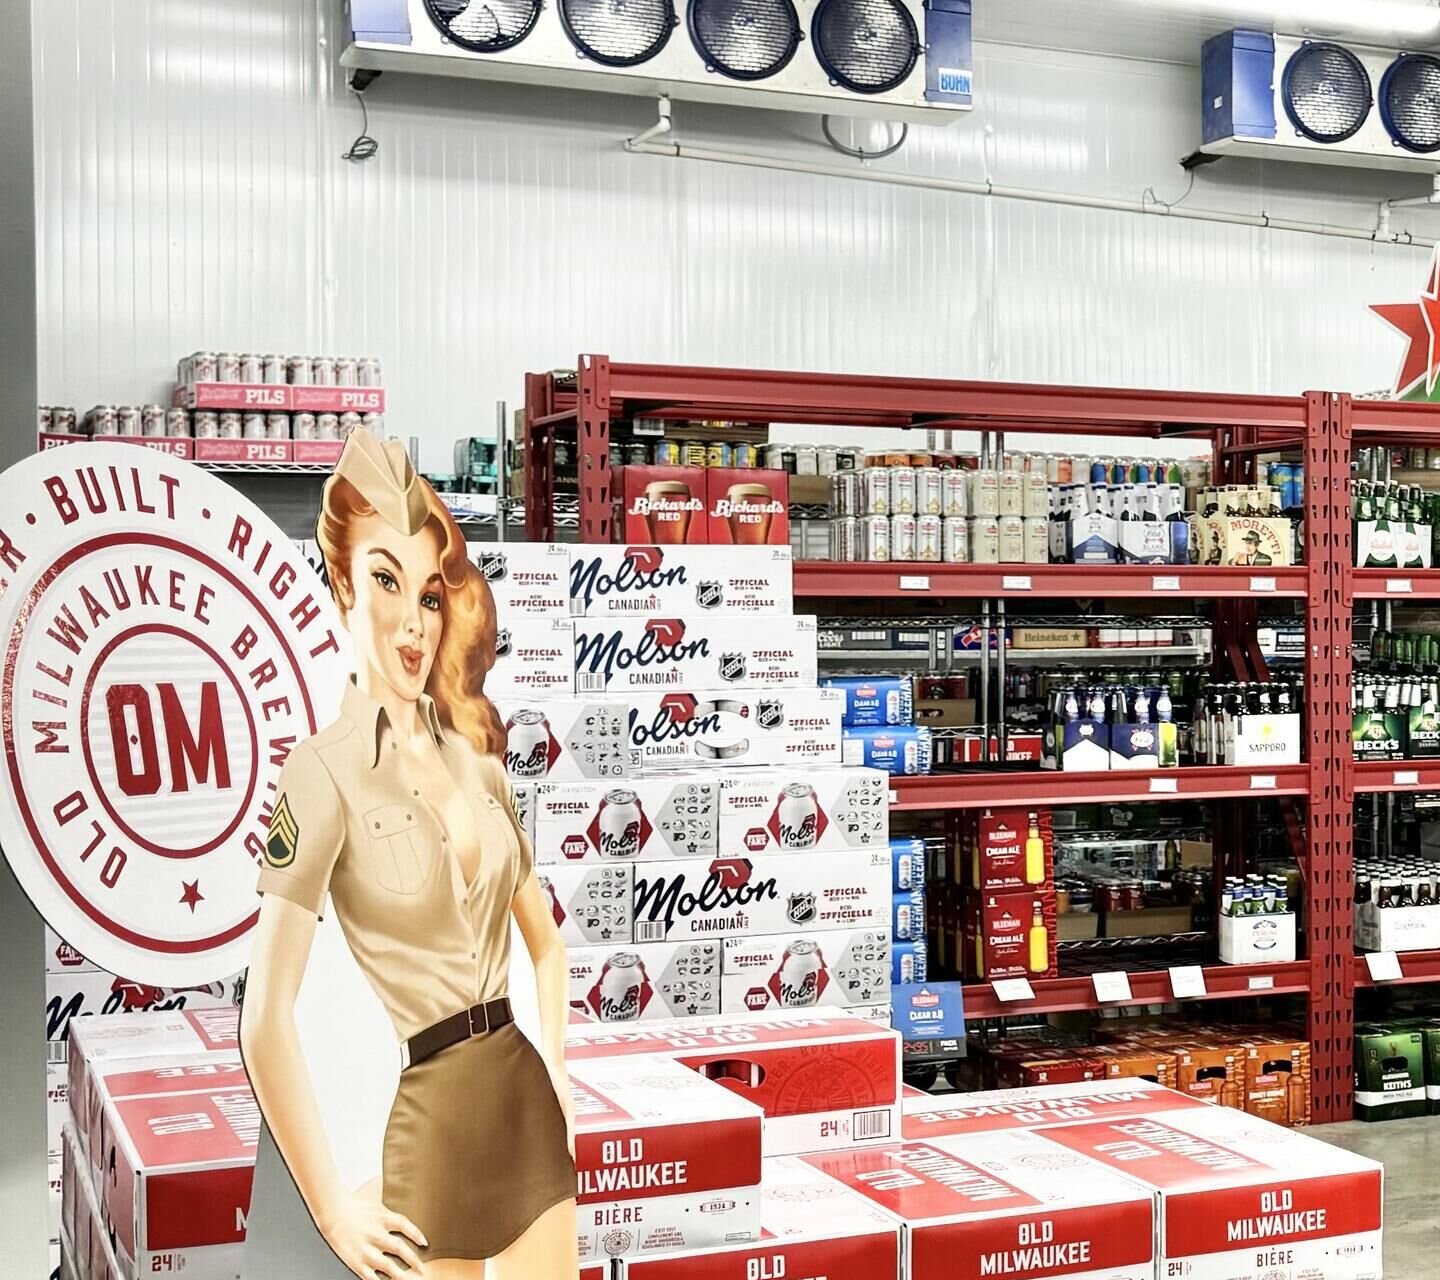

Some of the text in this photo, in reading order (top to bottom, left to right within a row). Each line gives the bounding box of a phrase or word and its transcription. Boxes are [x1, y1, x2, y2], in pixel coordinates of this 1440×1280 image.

[941, 72, 971, 95] BOHN
[246, 389, 286, 405] PILS
[341, 392, 381, 408] PILS
[247, 444, 287, 461] PILS
[628, 497, 704, 516] Rickard's
[711, 498, 785, 516] Rickard's
[658, 512, 681, 522] RED
[740, 513, 762, 524] RED
[1231, 518, 1282, 556] MORETTI
[43, 465, 340, 659] BUILT RIGHT
[513, 572, 559, 581] OFFICIAL
[570, 555, 688, 611] Molson
[509, 599, 565, 608] OFFICIELLE
[608, 594, 657, 610] CANADIAN
[1024, 632, 1069, 643] Heineken
[575, 630, 710, 685] Molson
[629, 667, 680, 685] CANADIAN
[33, 564, 297, 890] OLD MILWAUKEE BREWG
[104, 679, 234, 797] OM
[1249, 741, 1286, 753] SAPPORO
[1353, 739, 1399, 750] BECK'S
[824, 887, 868, 896] OFFICIAL
[635, 870, 778, 935] Molson
[691, 912, 744, 932] CANADIAN
[820, 908, 874, 919] OFFICIELLE
[820, 1120, 838, 1137] 24
[602, 1137, 643, 1165] OLD
[577, 1160, 688, 1195] ILWAUKEE
[1261, 1189, 1293, 1213] OLD
[594, 1202, 644, 1226] BIÈRE
[1018, 1220, 1054, 1245] OLD
[1227, 1208, 1327, 1242] MILWAUKEE
[746, 1253, 785, 1280] OLD
[980, 1239, 1090, 1276] MILWAUKEE
[1256, 1246, 1294, 1268] BIÈRE
